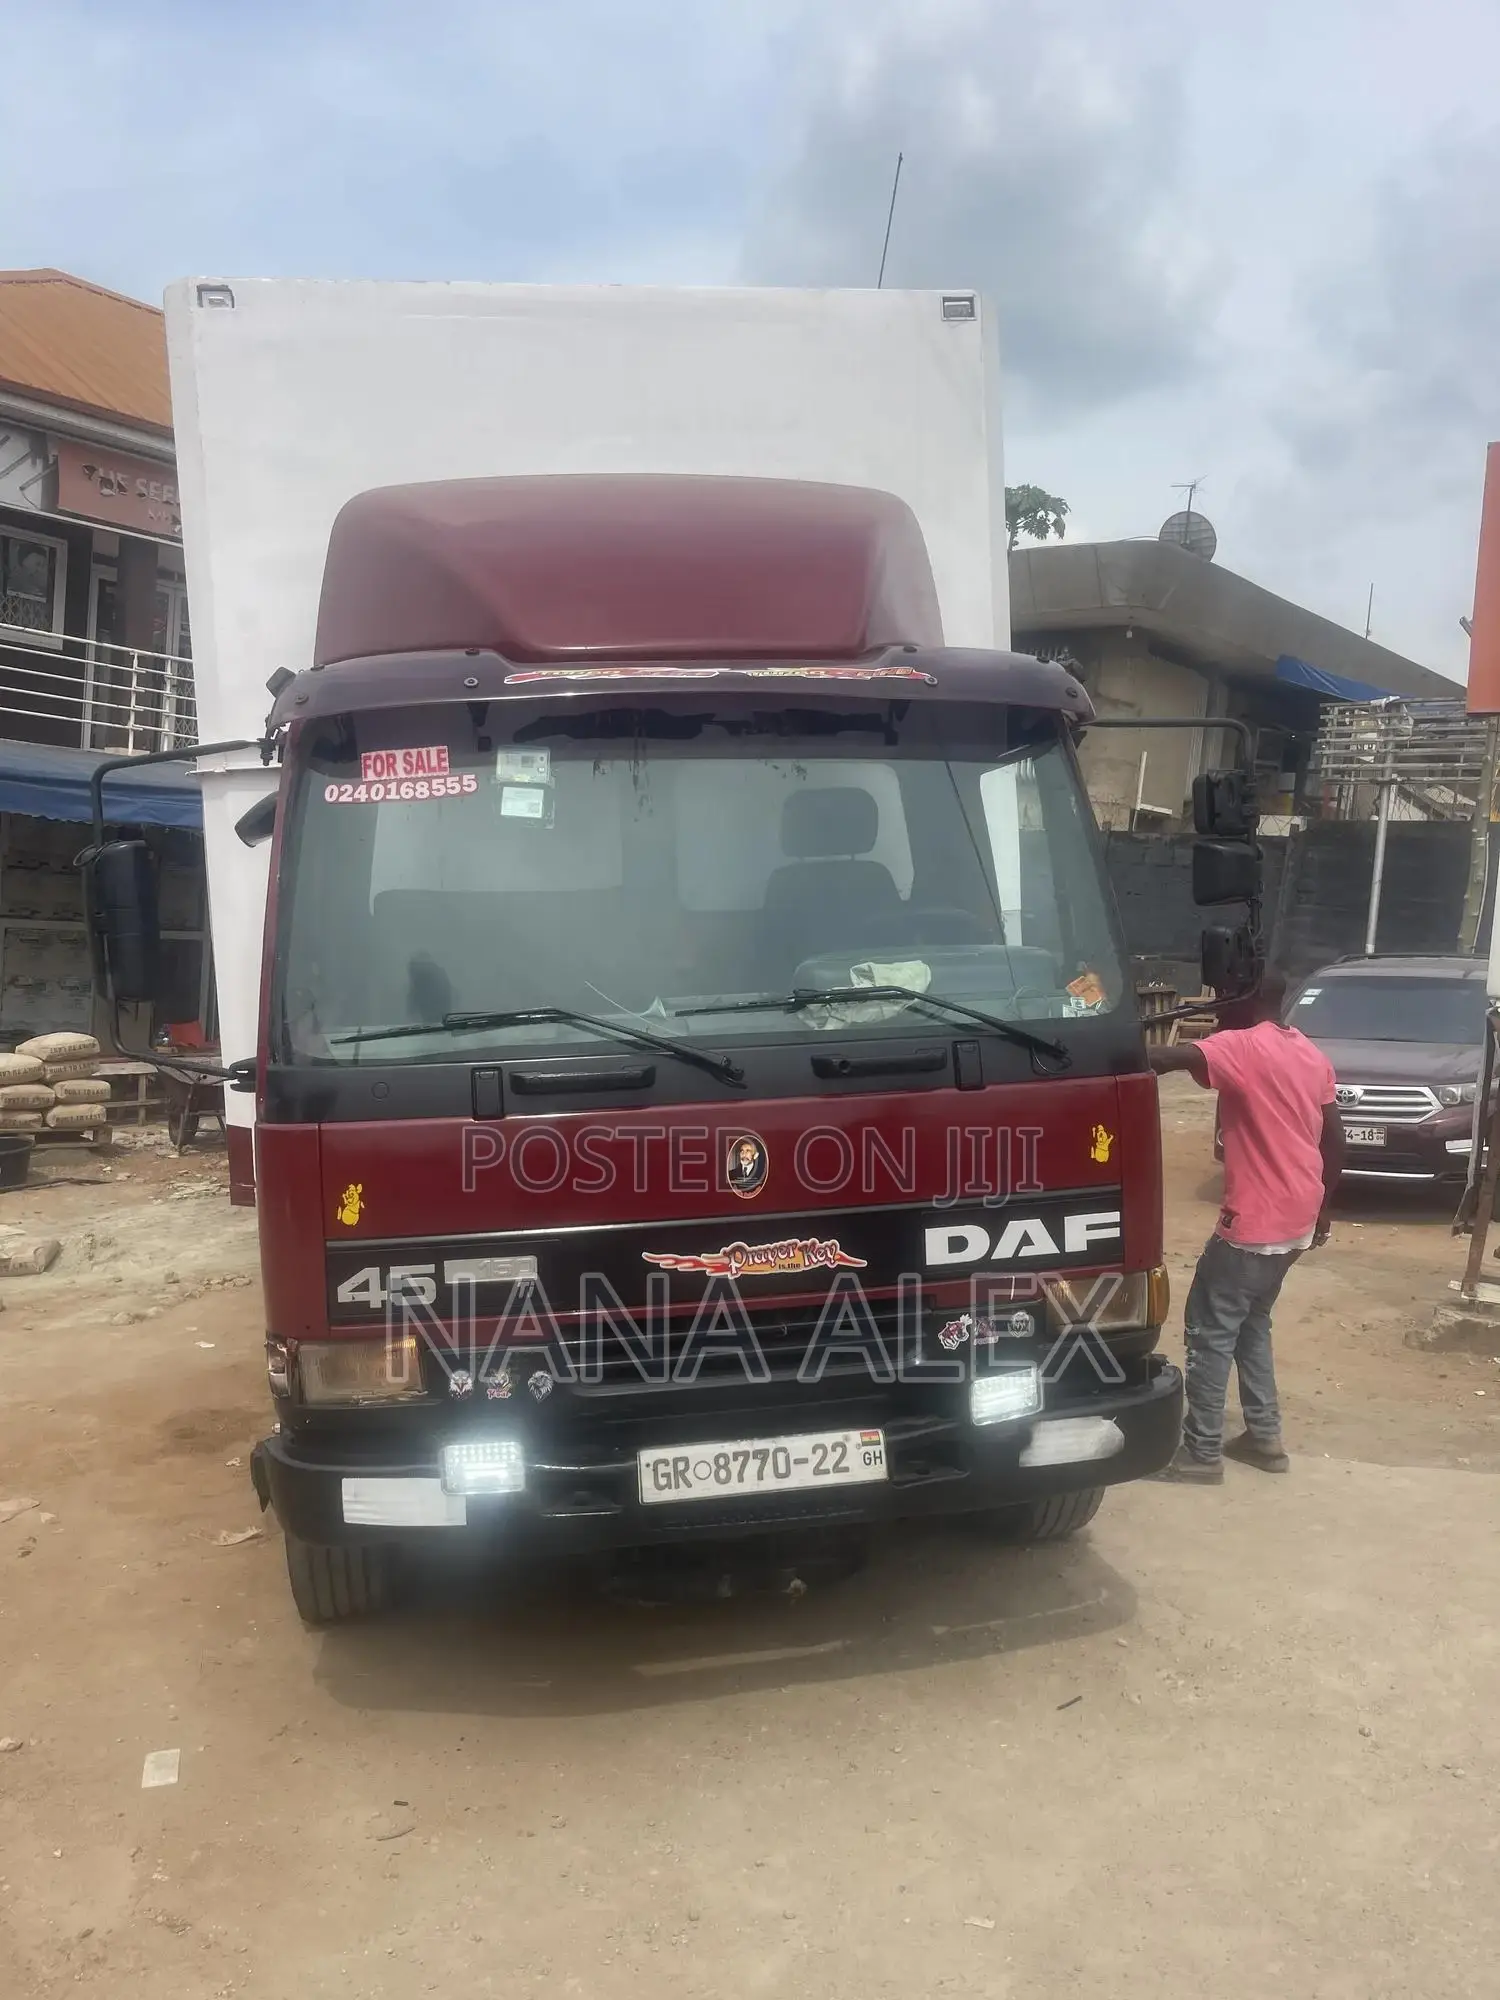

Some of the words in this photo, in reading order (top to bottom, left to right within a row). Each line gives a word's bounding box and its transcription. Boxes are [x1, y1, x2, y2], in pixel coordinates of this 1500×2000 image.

[135, 477, 180, 505] SEE
[363, 753, 398, 779] FOR
[402, 748, 448, 775] SALE
[324, 774, 477, 802] 0240168555
[1344, 1129, 1374, 1141] 4-18
[925, 1211, 1121, 1266] DAF
[724, 1240, 800, 1276] Prayer
[800, 1239, 839, 1267] Key
[787, 1262, 801, 1270] the
[332, 1264, 437, 1308] 45
[652, 1456, 693, 1491] GR
[713, 1441, 850, 1485] 8770-22
[862, 1450, 883, 1466] GH
